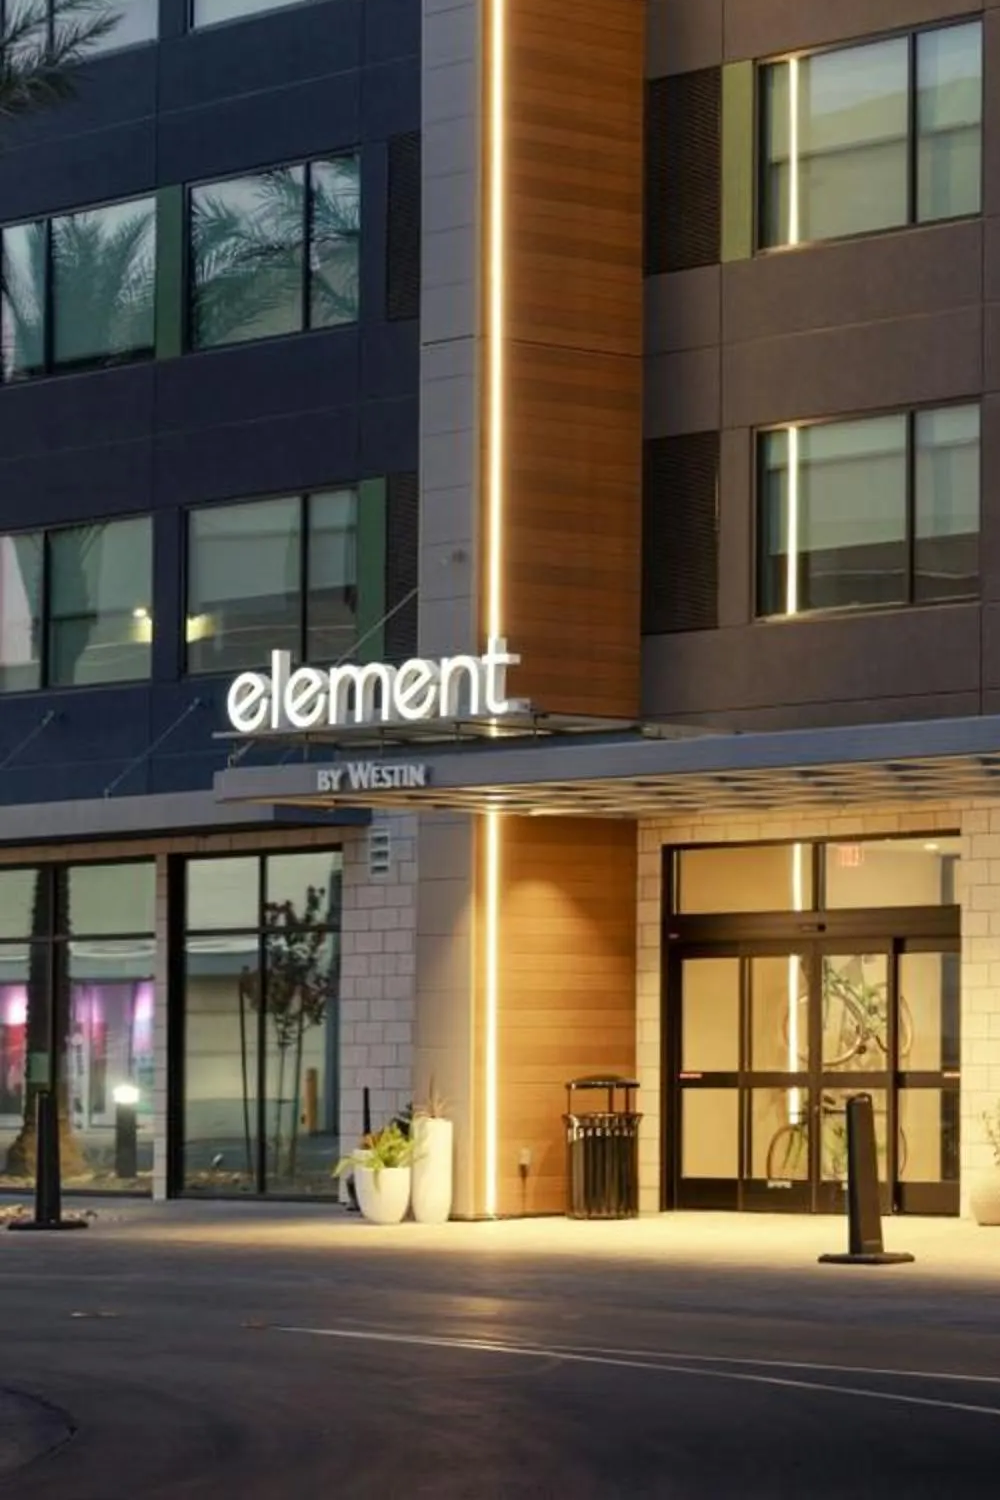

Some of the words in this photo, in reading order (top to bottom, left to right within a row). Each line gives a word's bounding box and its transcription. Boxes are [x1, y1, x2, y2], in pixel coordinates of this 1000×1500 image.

[227, 636, 523, 733] element
[317, 768, 342, 792] BY
[347, 761, 426, 790] WESTIN
